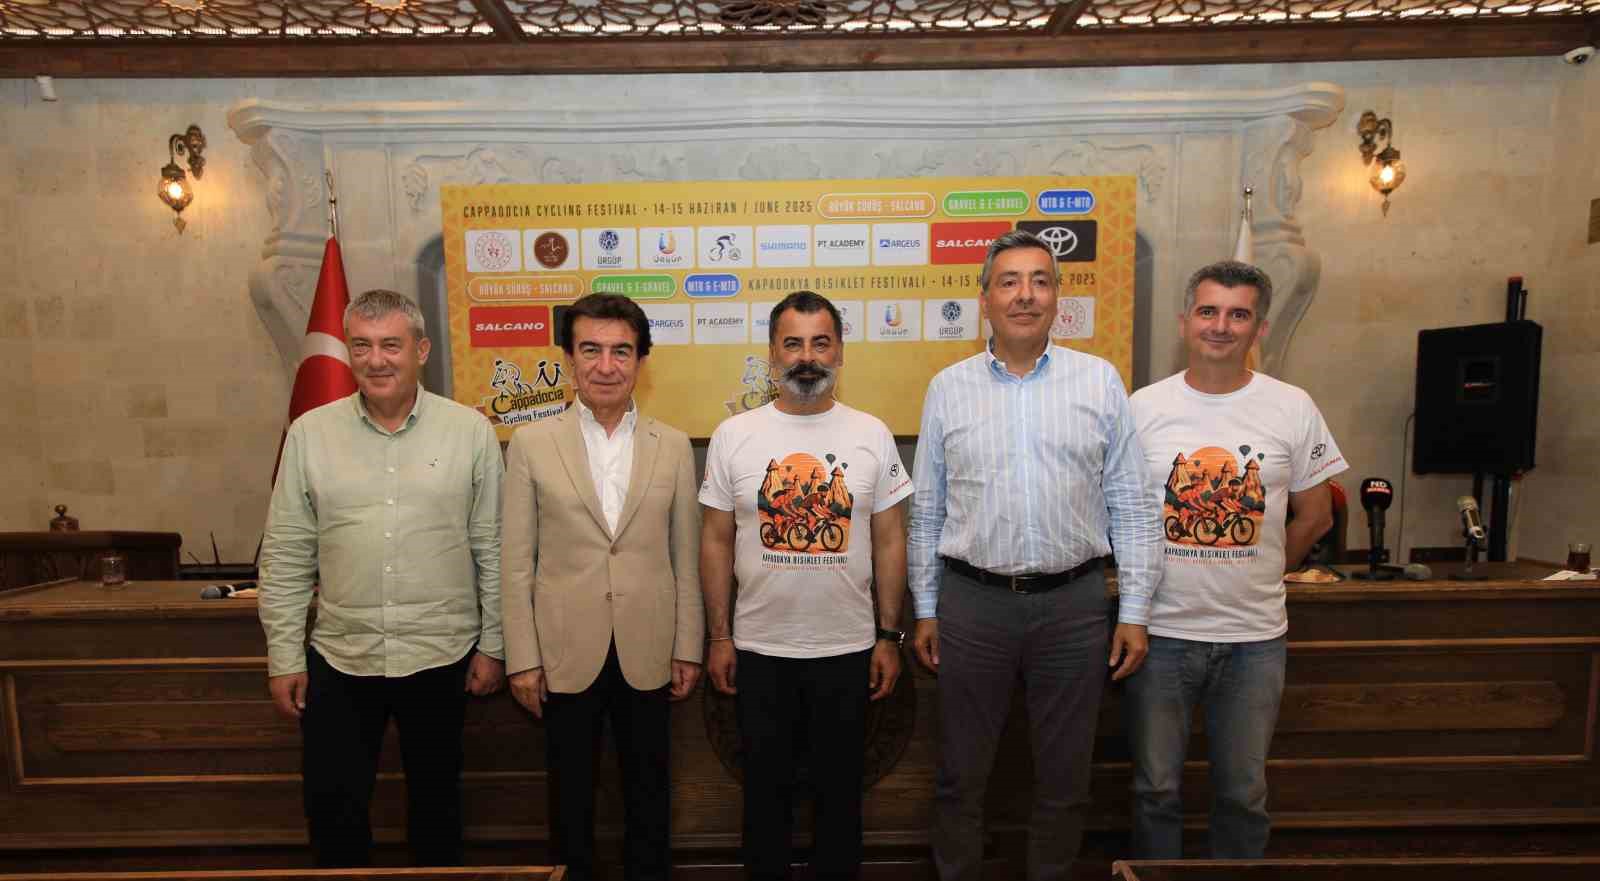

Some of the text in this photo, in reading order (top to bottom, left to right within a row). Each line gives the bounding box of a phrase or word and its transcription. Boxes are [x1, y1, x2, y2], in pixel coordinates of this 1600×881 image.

[463, 204, 530, 218] CAPPADOCIA
[536, 203, 581, 217] CYCLING
[587, 203, 637, 216] FESTIVAL
[654, 202, 683, 215] 14-15
[754, 201, 779, 214] JUNE
[785, 200, 813, 213] 2025
[817, 239, 865, 248] PT ACADEMY
[891, 239, 921, 249] ARGEUS
[935, 239, 994, 249] SALCAN
[748, 278, 809, 290] KAPADOKYA
[942, 274, 970, 288] 14-15
[1070, 272, 1096, 285] 2025
[475, 322, 544, 332] SALCANO
[655, 319, 684, 328] ARGEUS
[697, 318, 743, 326] PT ACADEMY
[491, 388, 565, 415] Cappadocia
[503, 405, 563, 425] Cycling Festival
